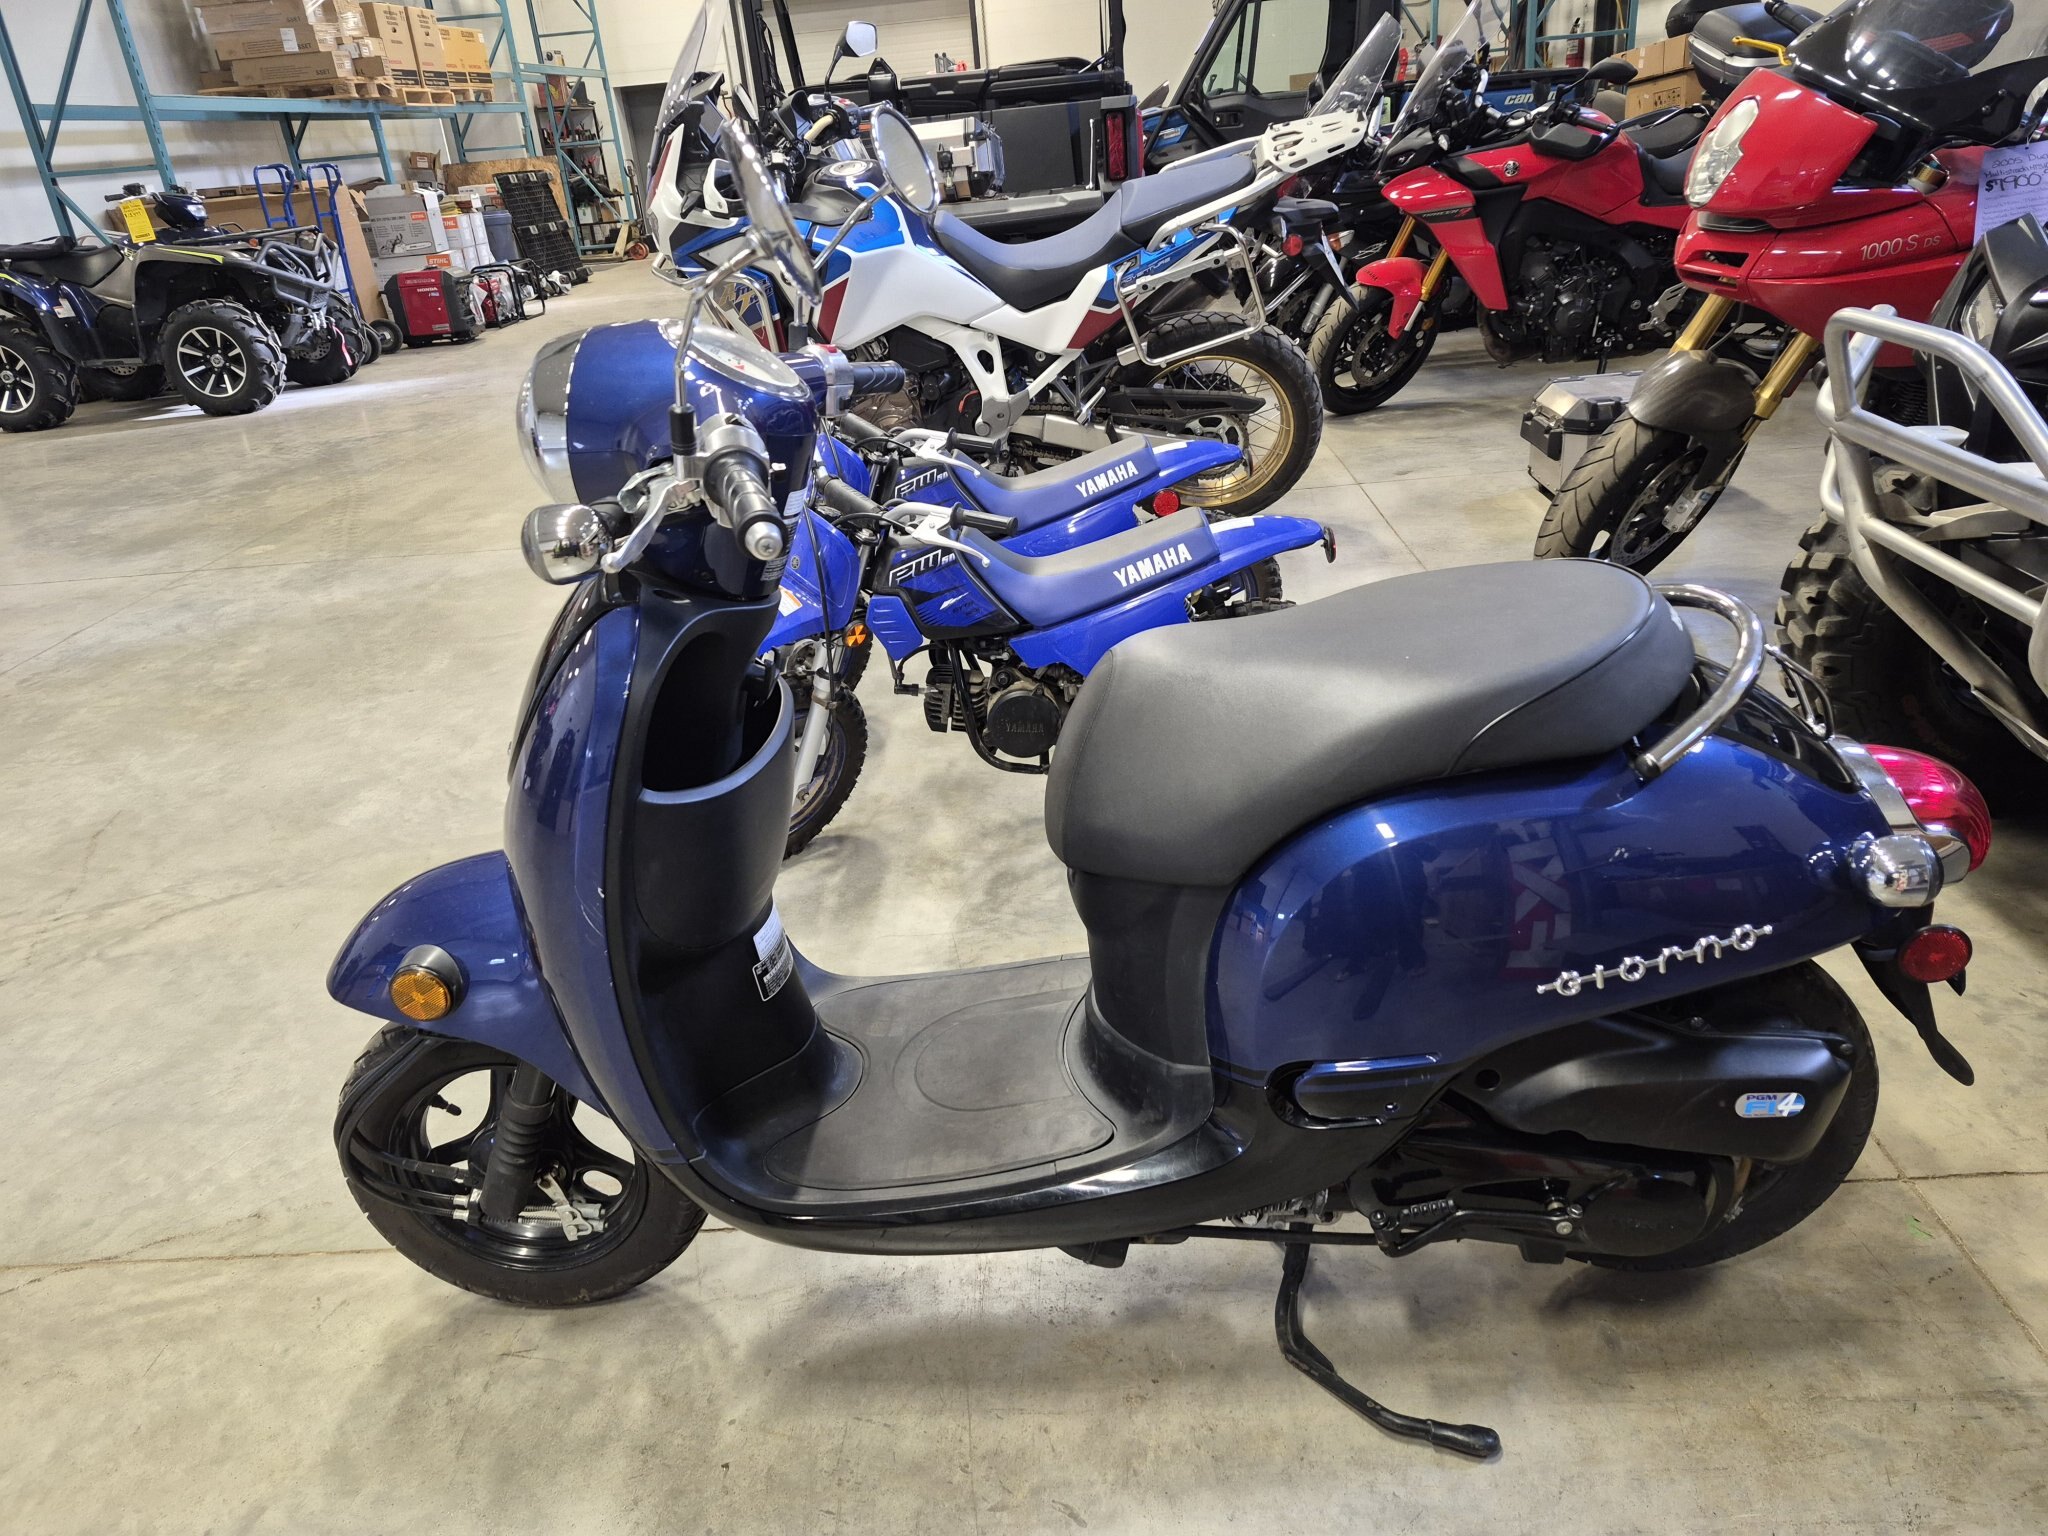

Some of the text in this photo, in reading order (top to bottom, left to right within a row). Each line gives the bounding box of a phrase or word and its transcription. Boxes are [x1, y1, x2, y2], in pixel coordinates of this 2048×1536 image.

[428, 257, 449, 265] STIHL
[1860, 234, 1941, 261] 1000 S DS
[1075, 460, 1139, 498] YAMAHA
[1112, 543, 1193, 588] YAMAHA
